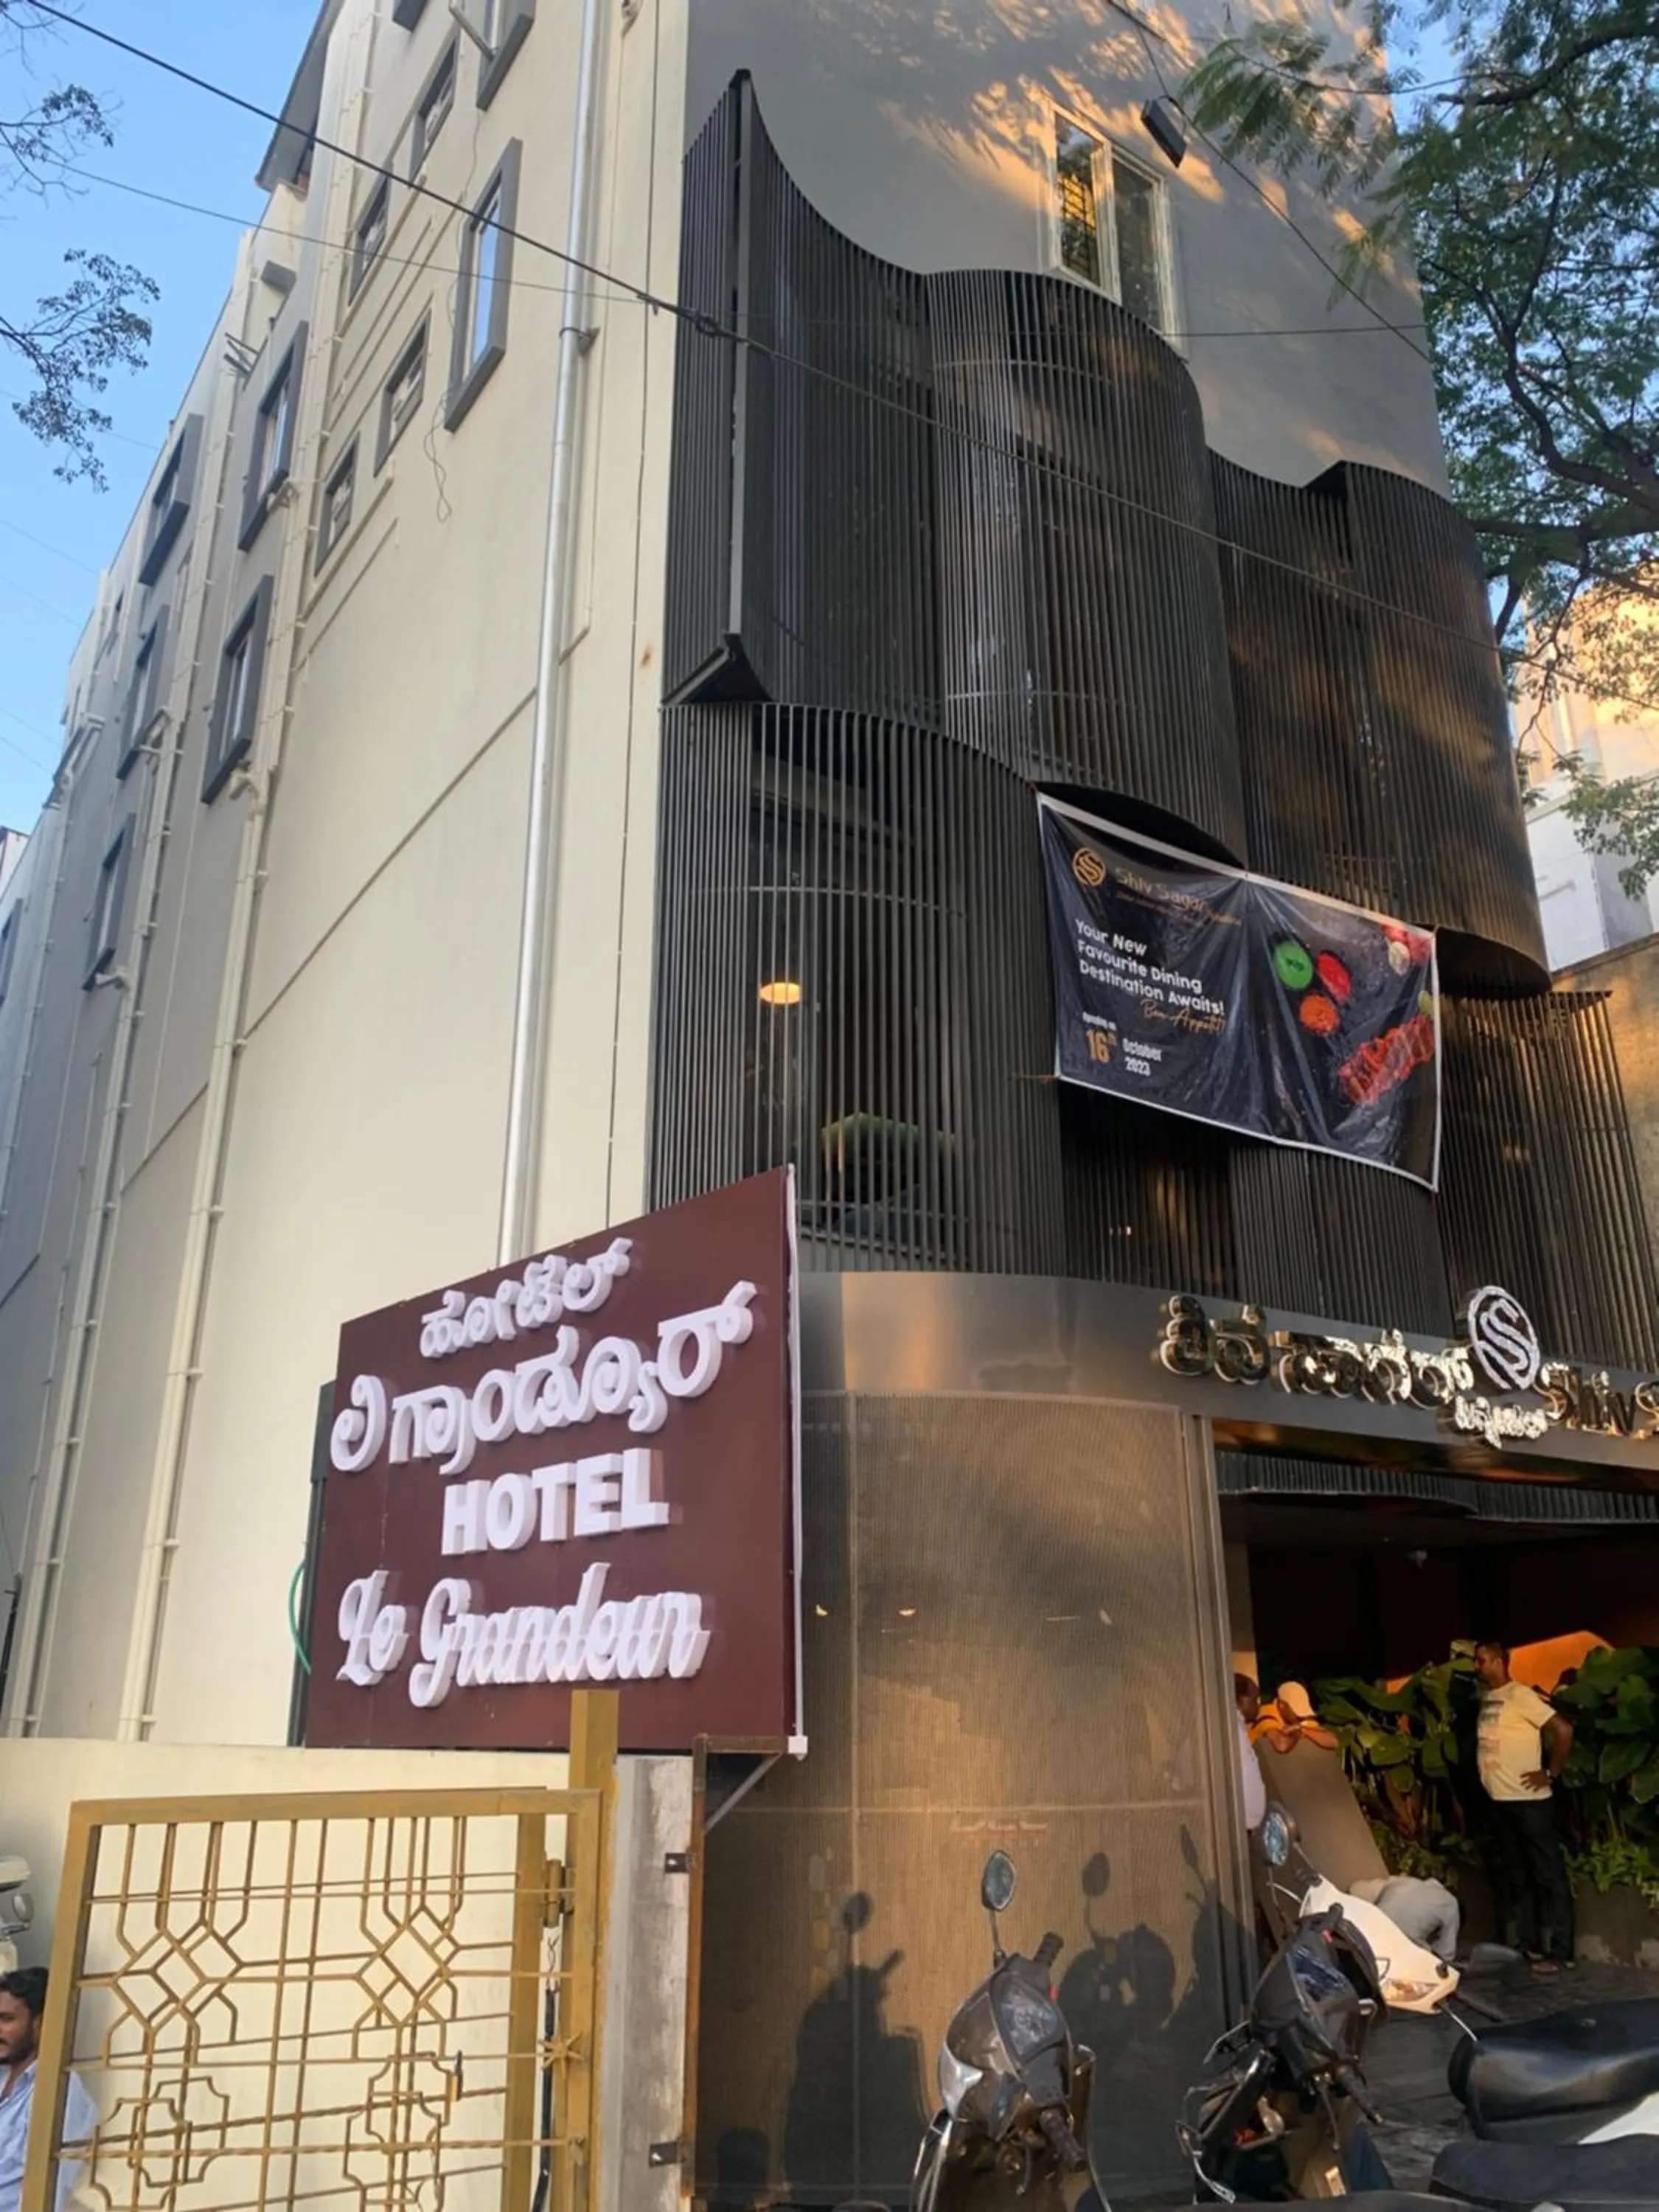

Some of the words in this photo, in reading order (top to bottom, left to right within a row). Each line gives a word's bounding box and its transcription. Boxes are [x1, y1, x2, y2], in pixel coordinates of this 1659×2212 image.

[1075, 919, 1109, 943] Your
[1113, 933, 1147, 956] New
[1077, 939, 1148, 977] Favourite
[1150, 967, 1203, 994] Dining
[1079, 959, 1164, 1001] Destination
[1168, 990, 1225, 1015] Awaits!
[1122, 1037, 1162, 1062] October
[1124, 1056, 1151, 1077] 2023
[420, 1237, 633, 1358] ಹೋಟೆಲ್
[330, 1374, 387, 1472] ಲಿ
[442, 1448, 669, 1555] HOTEL
[336, 1570, 408, 1686] Le
[409, 1562, 711, 1708] Grandeur
